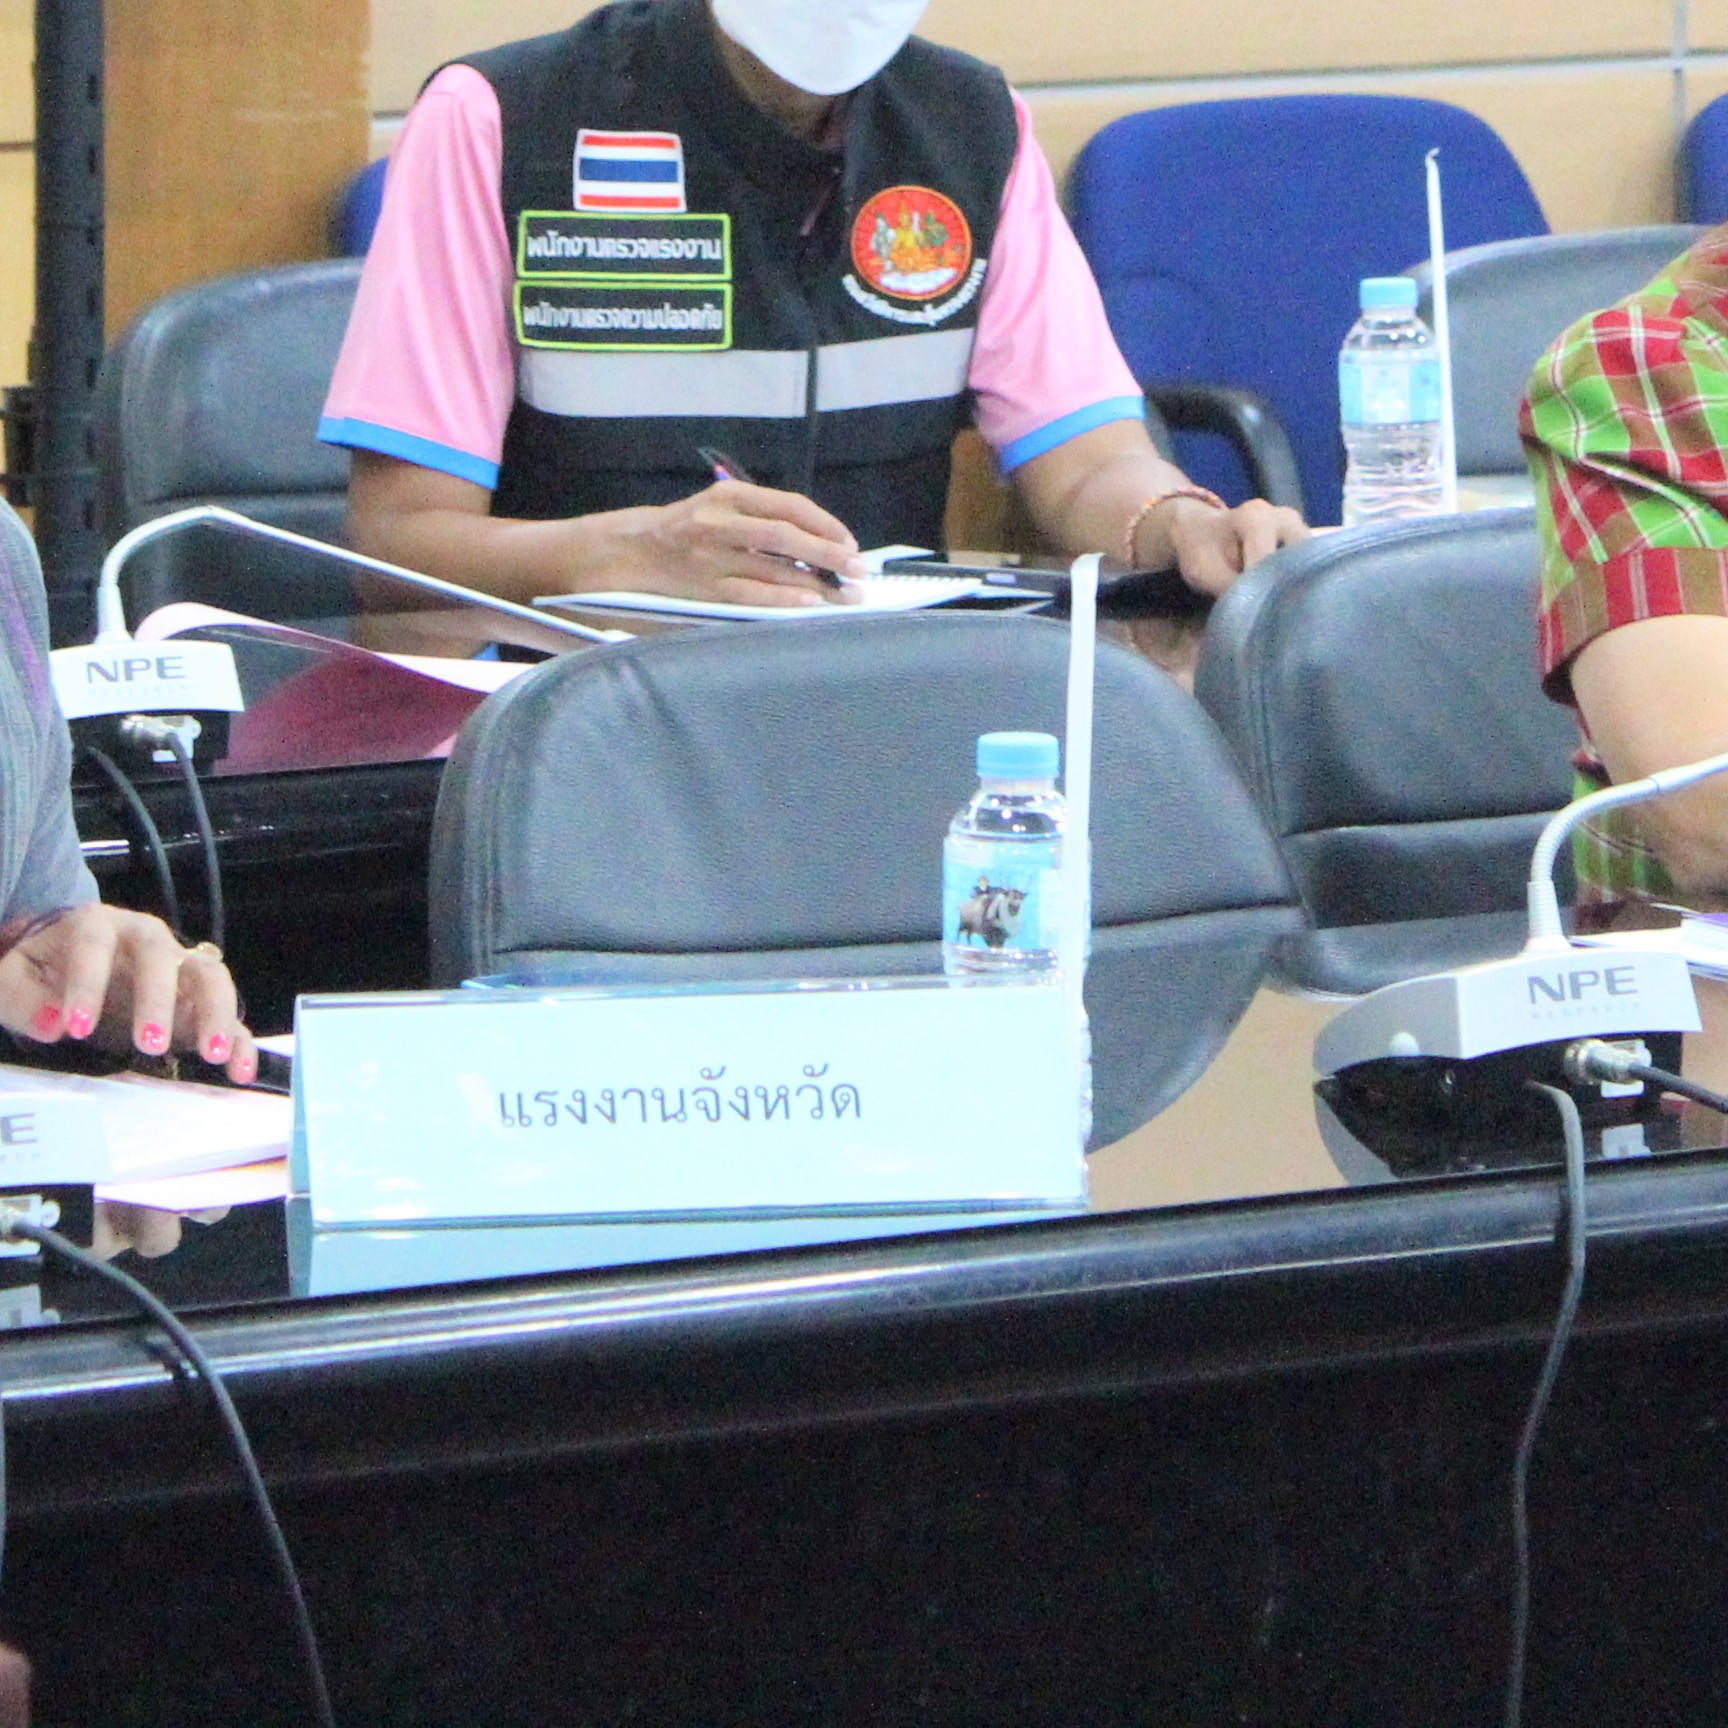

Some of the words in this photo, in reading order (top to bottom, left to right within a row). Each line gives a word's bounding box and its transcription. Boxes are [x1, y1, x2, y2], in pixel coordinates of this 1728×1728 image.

[86, 655, 187, 684] NPE
[1528, 965, 1639, 1005] NPE
[499, 1062, 863, 1129] แรงงานจังหวัด
